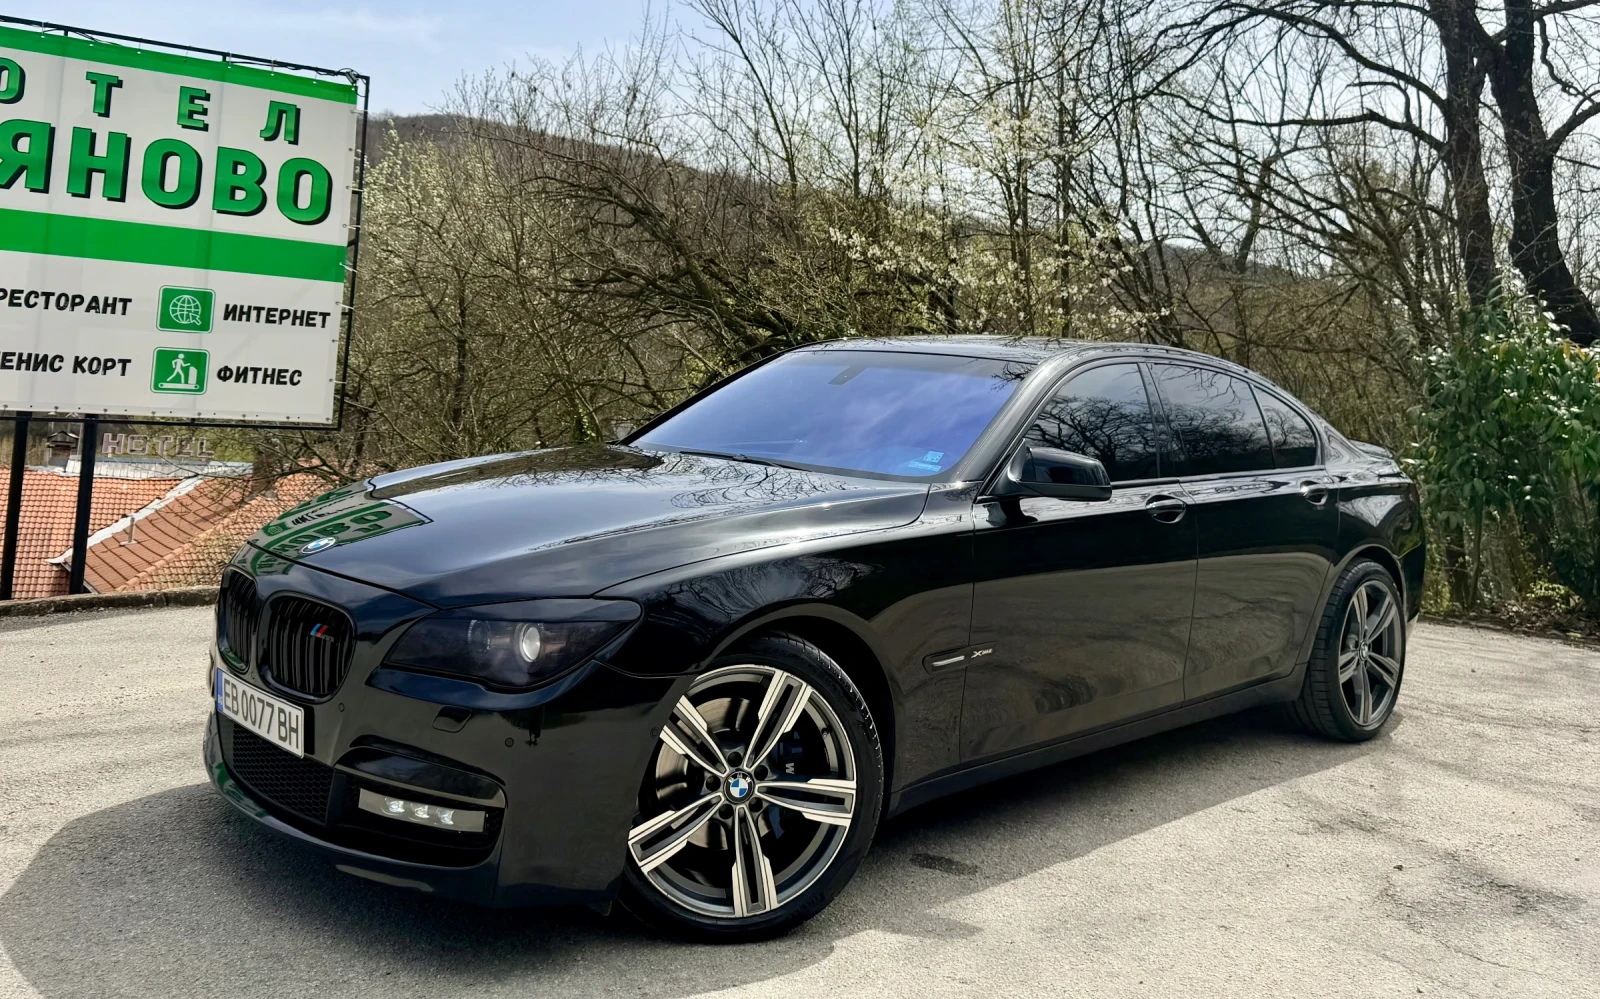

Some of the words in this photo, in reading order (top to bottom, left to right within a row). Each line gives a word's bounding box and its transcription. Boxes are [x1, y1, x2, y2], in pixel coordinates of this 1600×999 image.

[0, 119, 334, 226] ЯНОВО
[223, 304, 331, 329] ИНТЕРНЕТ
[0, 351, 64, 373] ЕНИС
[72, 355, 132, 377] КОРТ
[216, 365, 303, 387] ФИТНЕС
[101, 432, 215, 459] HOTEL
[223, 678, 240, 717] EB
[241, 689, 275, 735] 0077
[277, 706, 299, 750] BH
